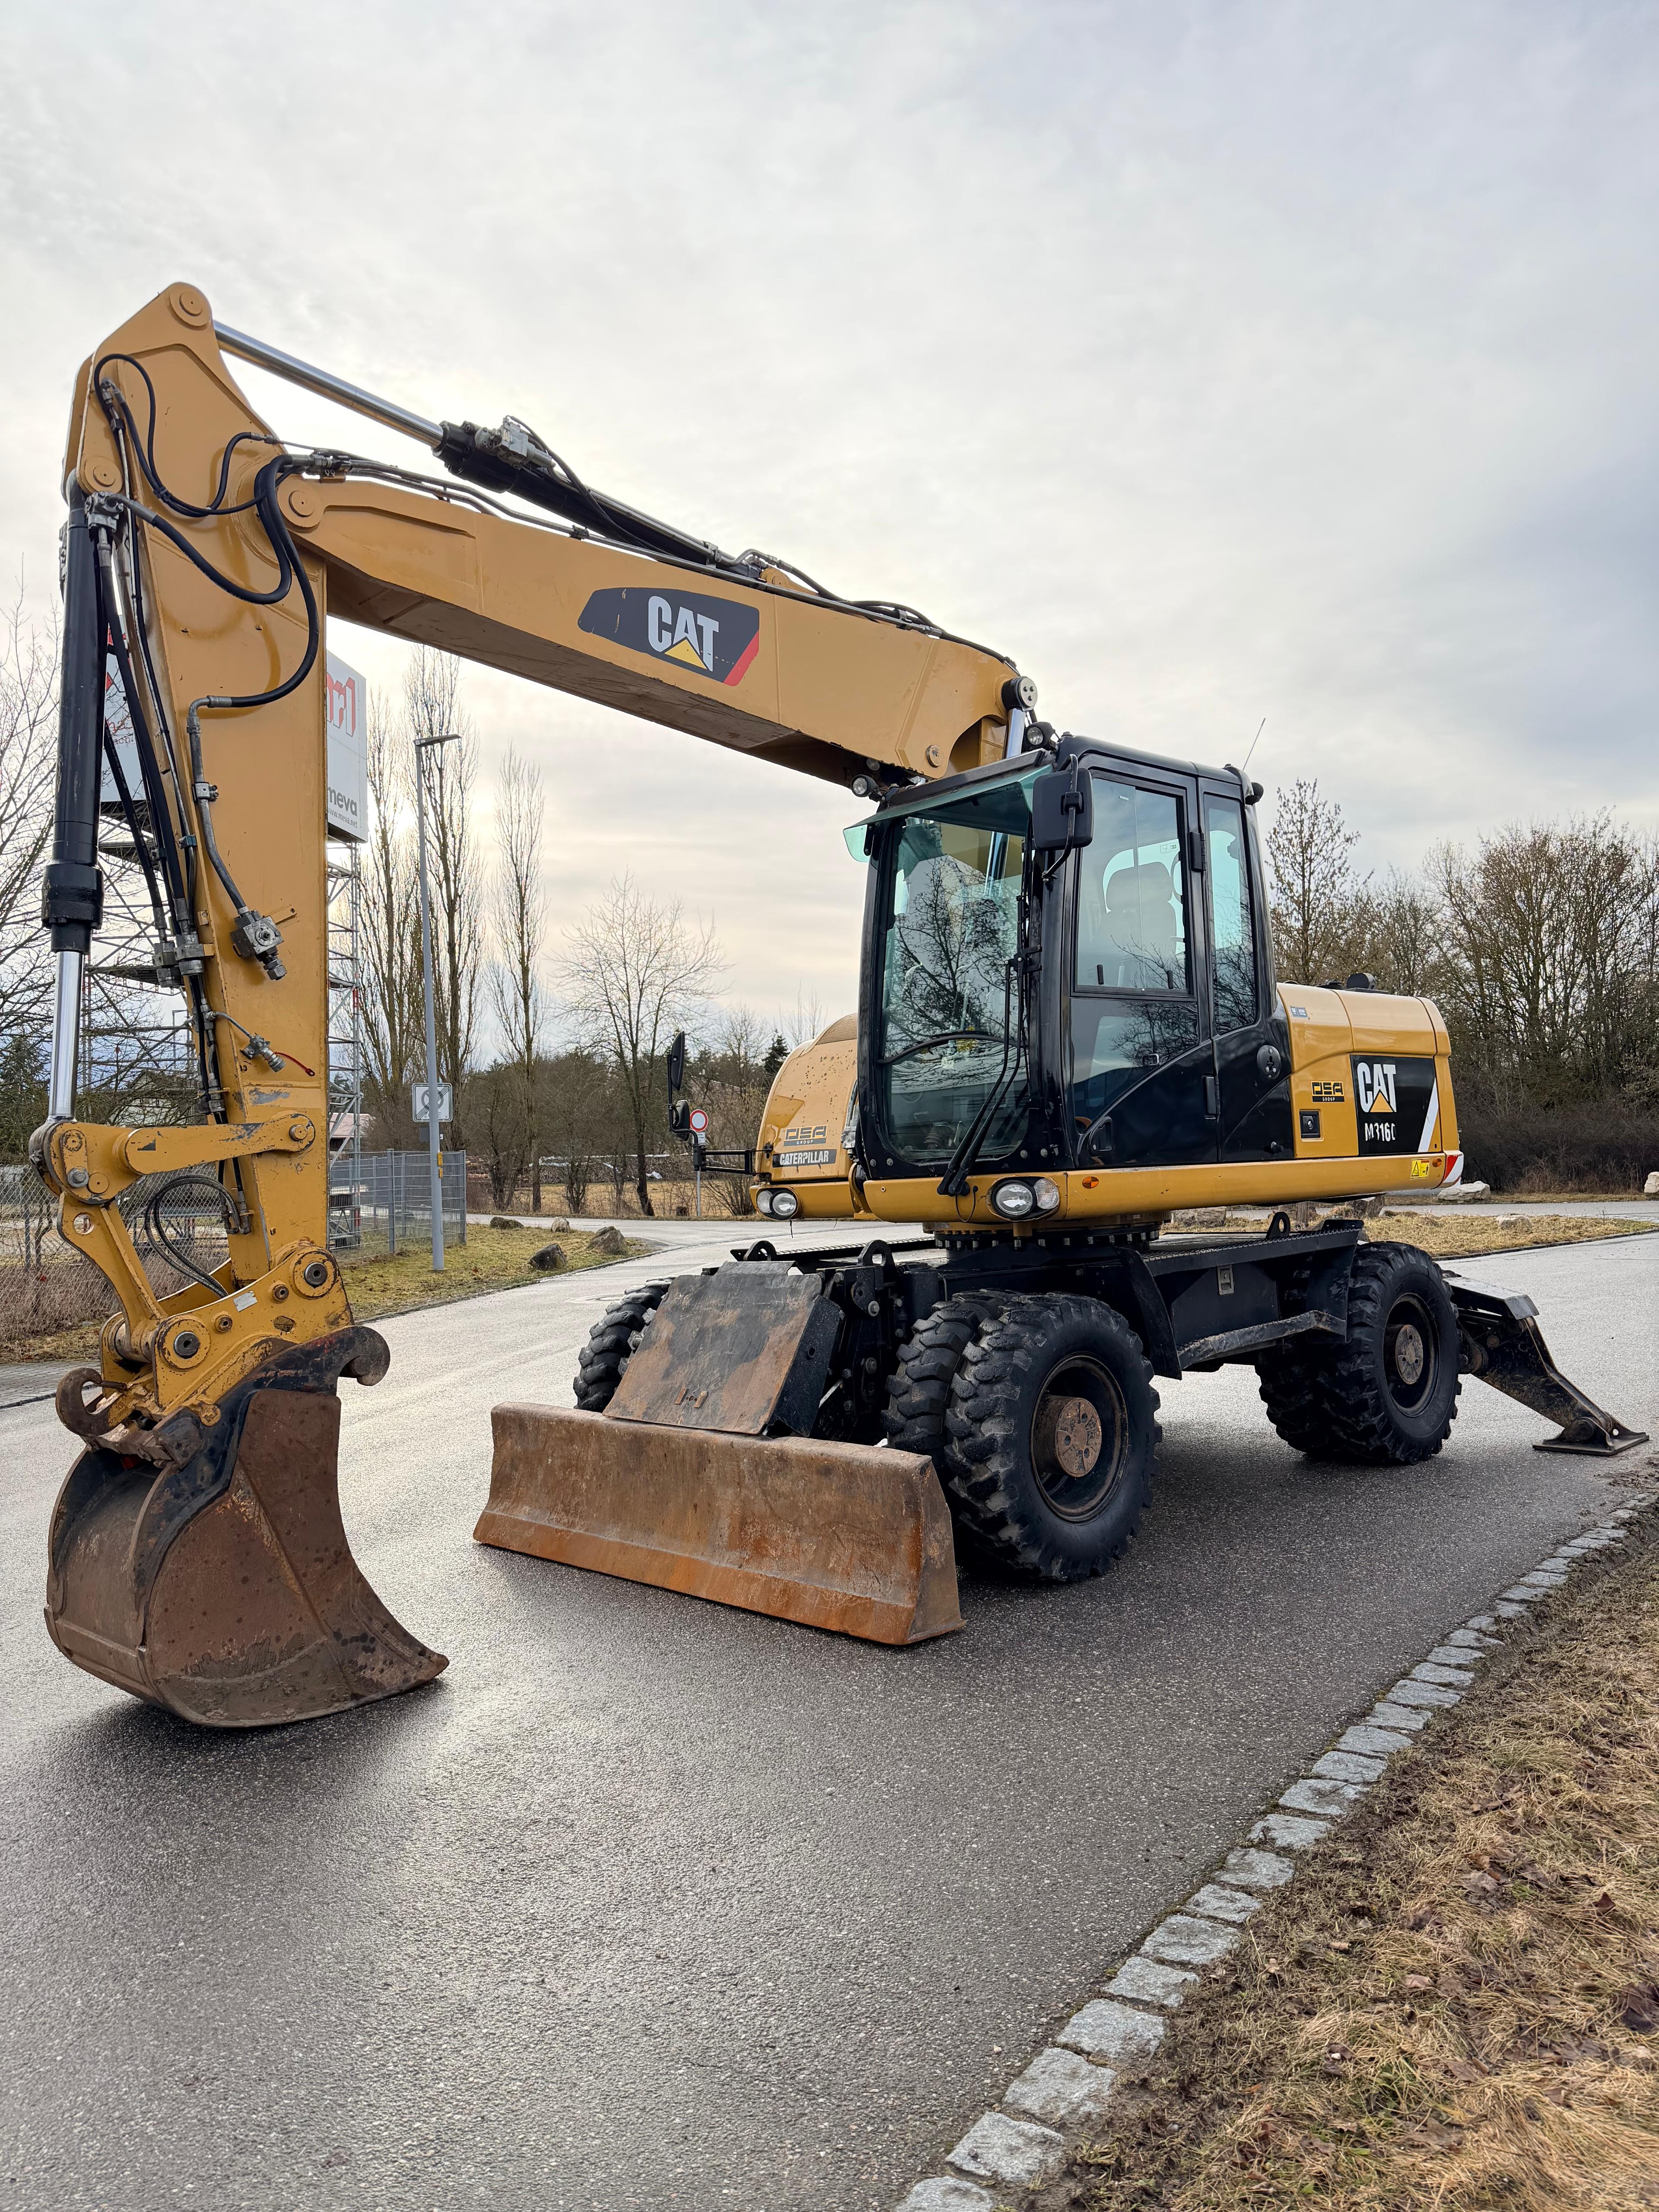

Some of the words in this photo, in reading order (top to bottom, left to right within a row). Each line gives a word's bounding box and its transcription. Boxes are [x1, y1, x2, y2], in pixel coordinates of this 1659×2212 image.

[648, 596, 719, 672] CAT
[1357, 1062, 1397, 1112] CAT
[779, 1150, 829, 1166] CATERPILLAR
